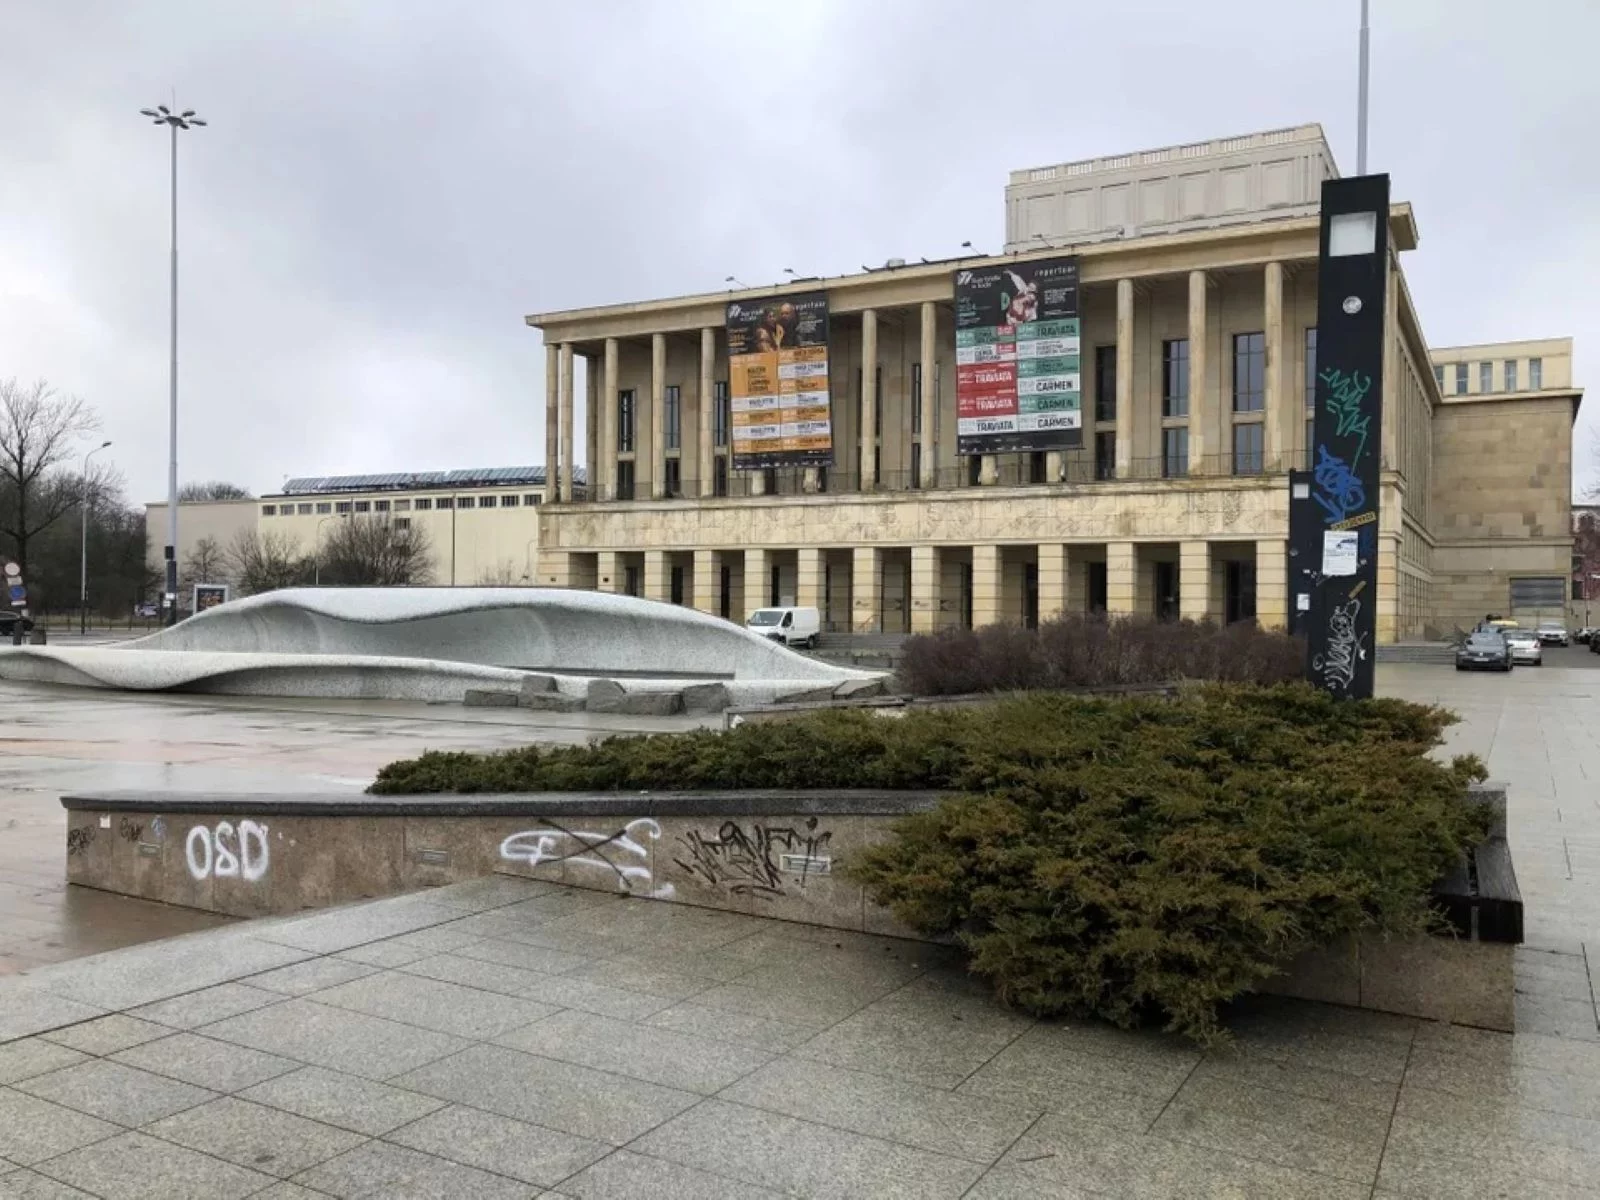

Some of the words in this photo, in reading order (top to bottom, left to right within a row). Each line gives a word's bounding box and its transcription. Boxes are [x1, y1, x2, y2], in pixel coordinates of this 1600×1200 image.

[975, 371, 1012, 384] TRAVIATA
[1036, 380, 1073, 392] CARMEN
[976, 398, 1013, 410] TRAVIATA
[1037, 399, 1074, 410] CARMEN
[977, 421, 1014, 432] TRAVIATA
[1037, 417, 1074, 429] CARMEN
